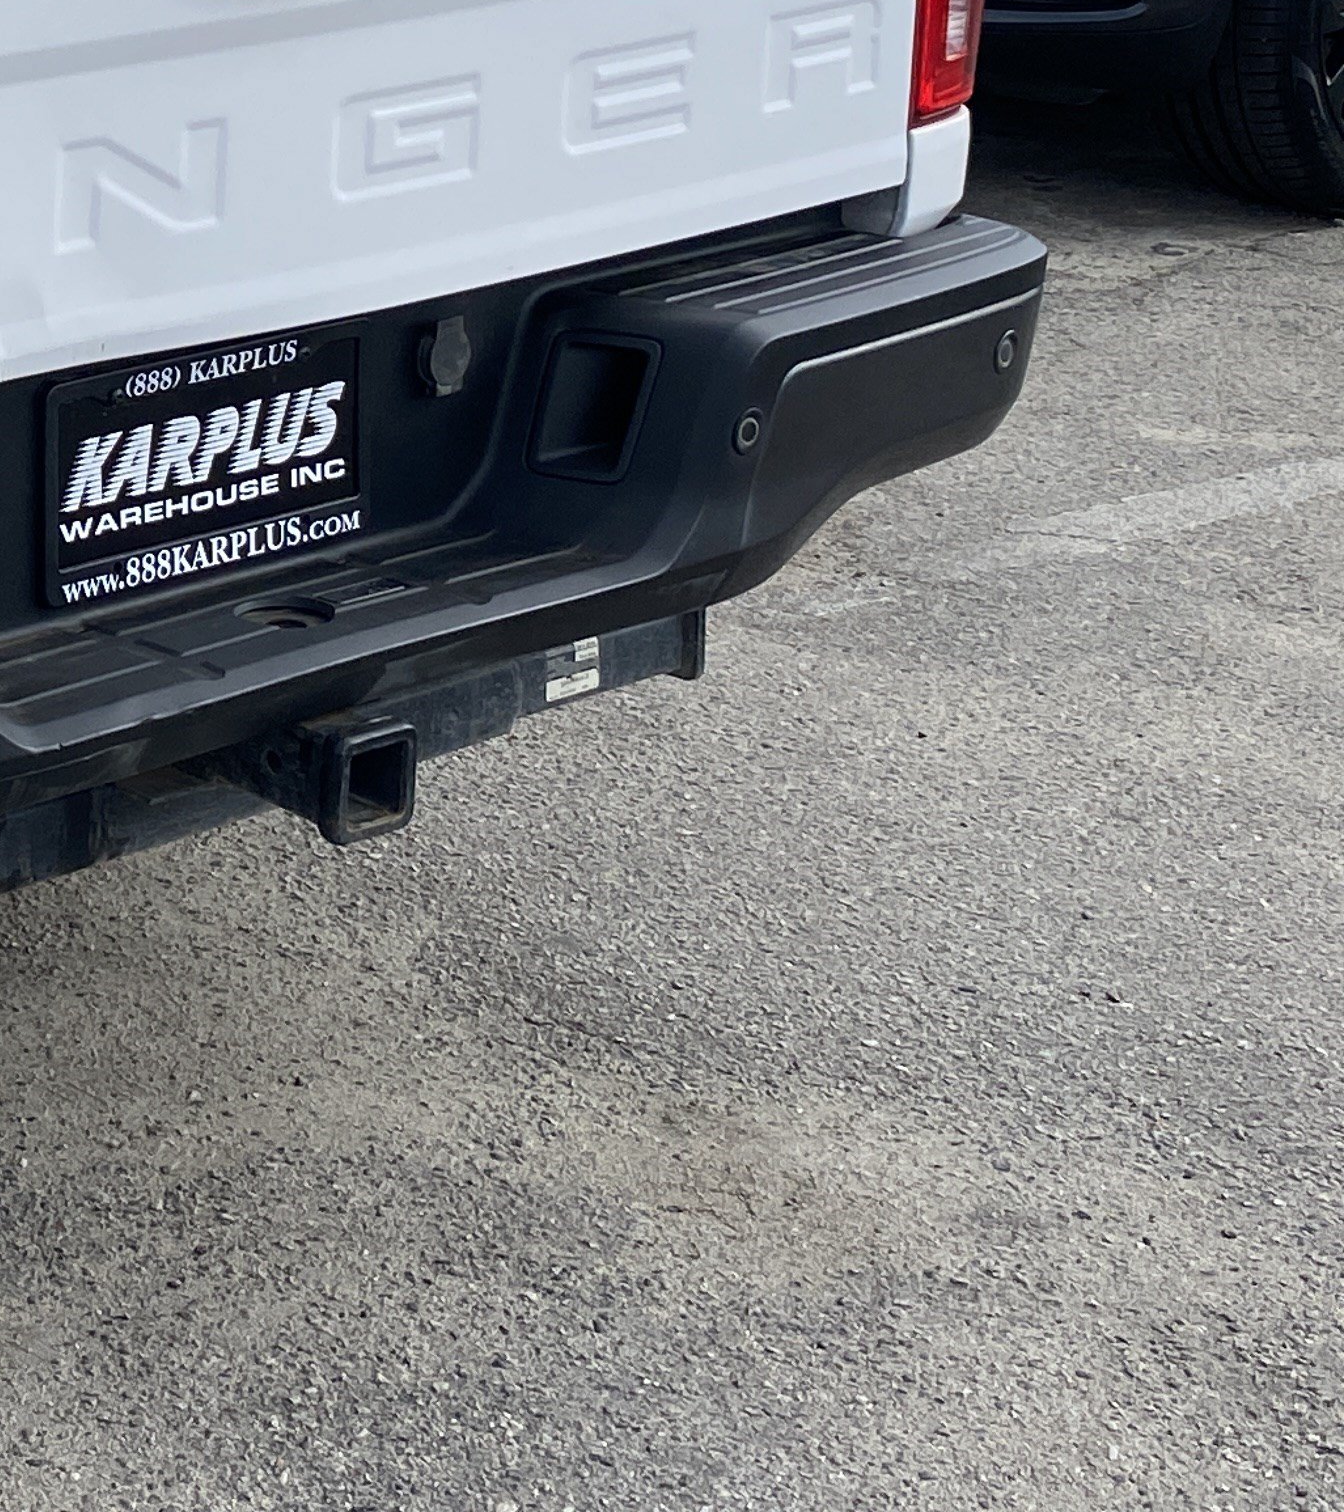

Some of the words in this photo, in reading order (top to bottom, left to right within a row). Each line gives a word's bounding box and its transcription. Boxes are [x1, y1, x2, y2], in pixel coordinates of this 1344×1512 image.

[125, 366, 180, 399] (888)
[188, 339, 298, 386] KARPLUS
[59, 381, 346, 513] KARPLUS
[59, 473, 279, 543] WAREHOUSE
[291, 458, 347, 488] INC
